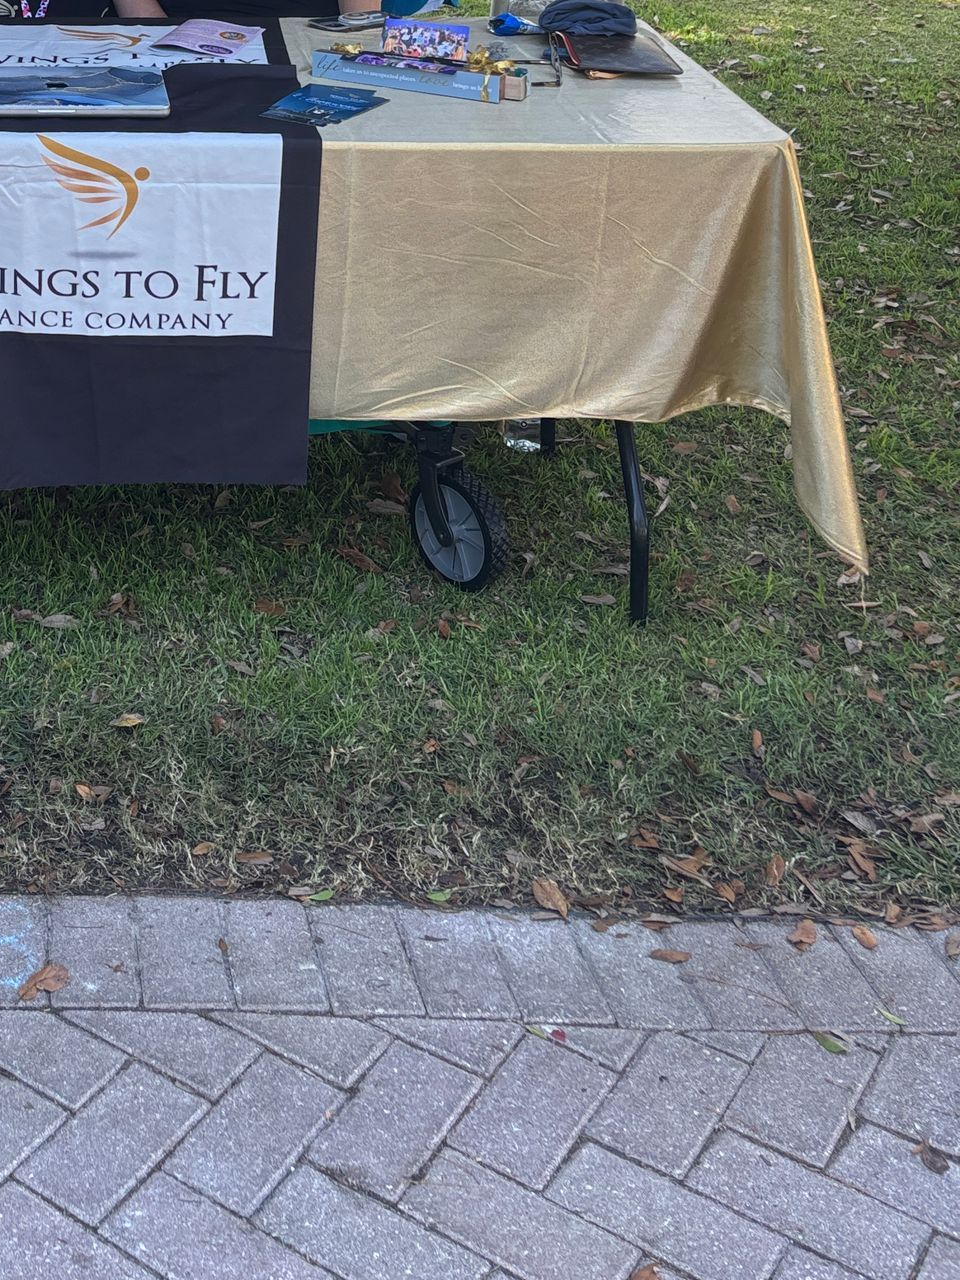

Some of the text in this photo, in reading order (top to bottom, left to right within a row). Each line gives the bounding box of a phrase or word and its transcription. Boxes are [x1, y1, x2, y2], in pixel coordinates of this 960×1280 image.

[114, 270, 179, 299] TO
[194, 264, 269, 302] FLY
[85, 311, 234, 330] COMPANY
